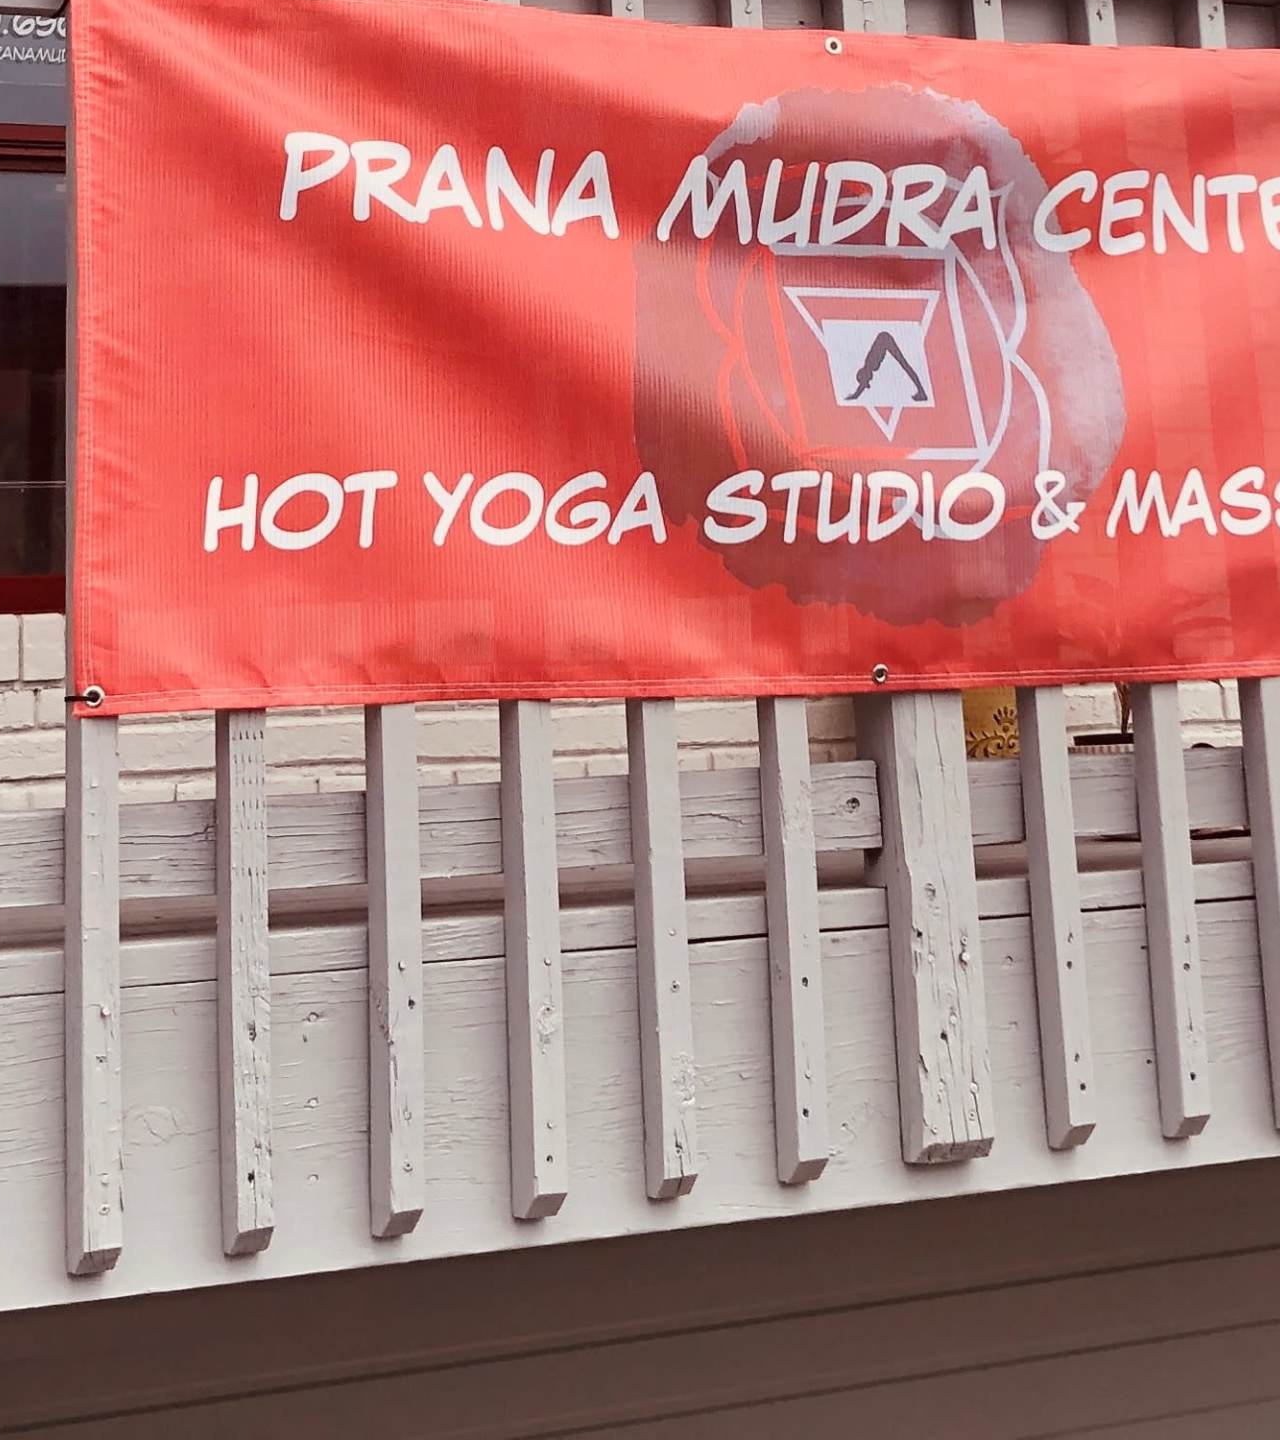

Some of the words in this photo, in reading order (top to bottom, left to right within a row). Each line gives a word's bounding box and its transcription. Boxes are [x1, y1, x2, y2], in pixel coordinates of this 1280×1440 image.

[279, 131, 620, 239] PRANA
[656, 155, 997, 251] MUDRA
[203, 470, 398, 552] HOT
[423, 470, 667, 547] YOGA
[704, 469, 1006, 544] STUDIO
[1031, 469, 1083, 540] &
